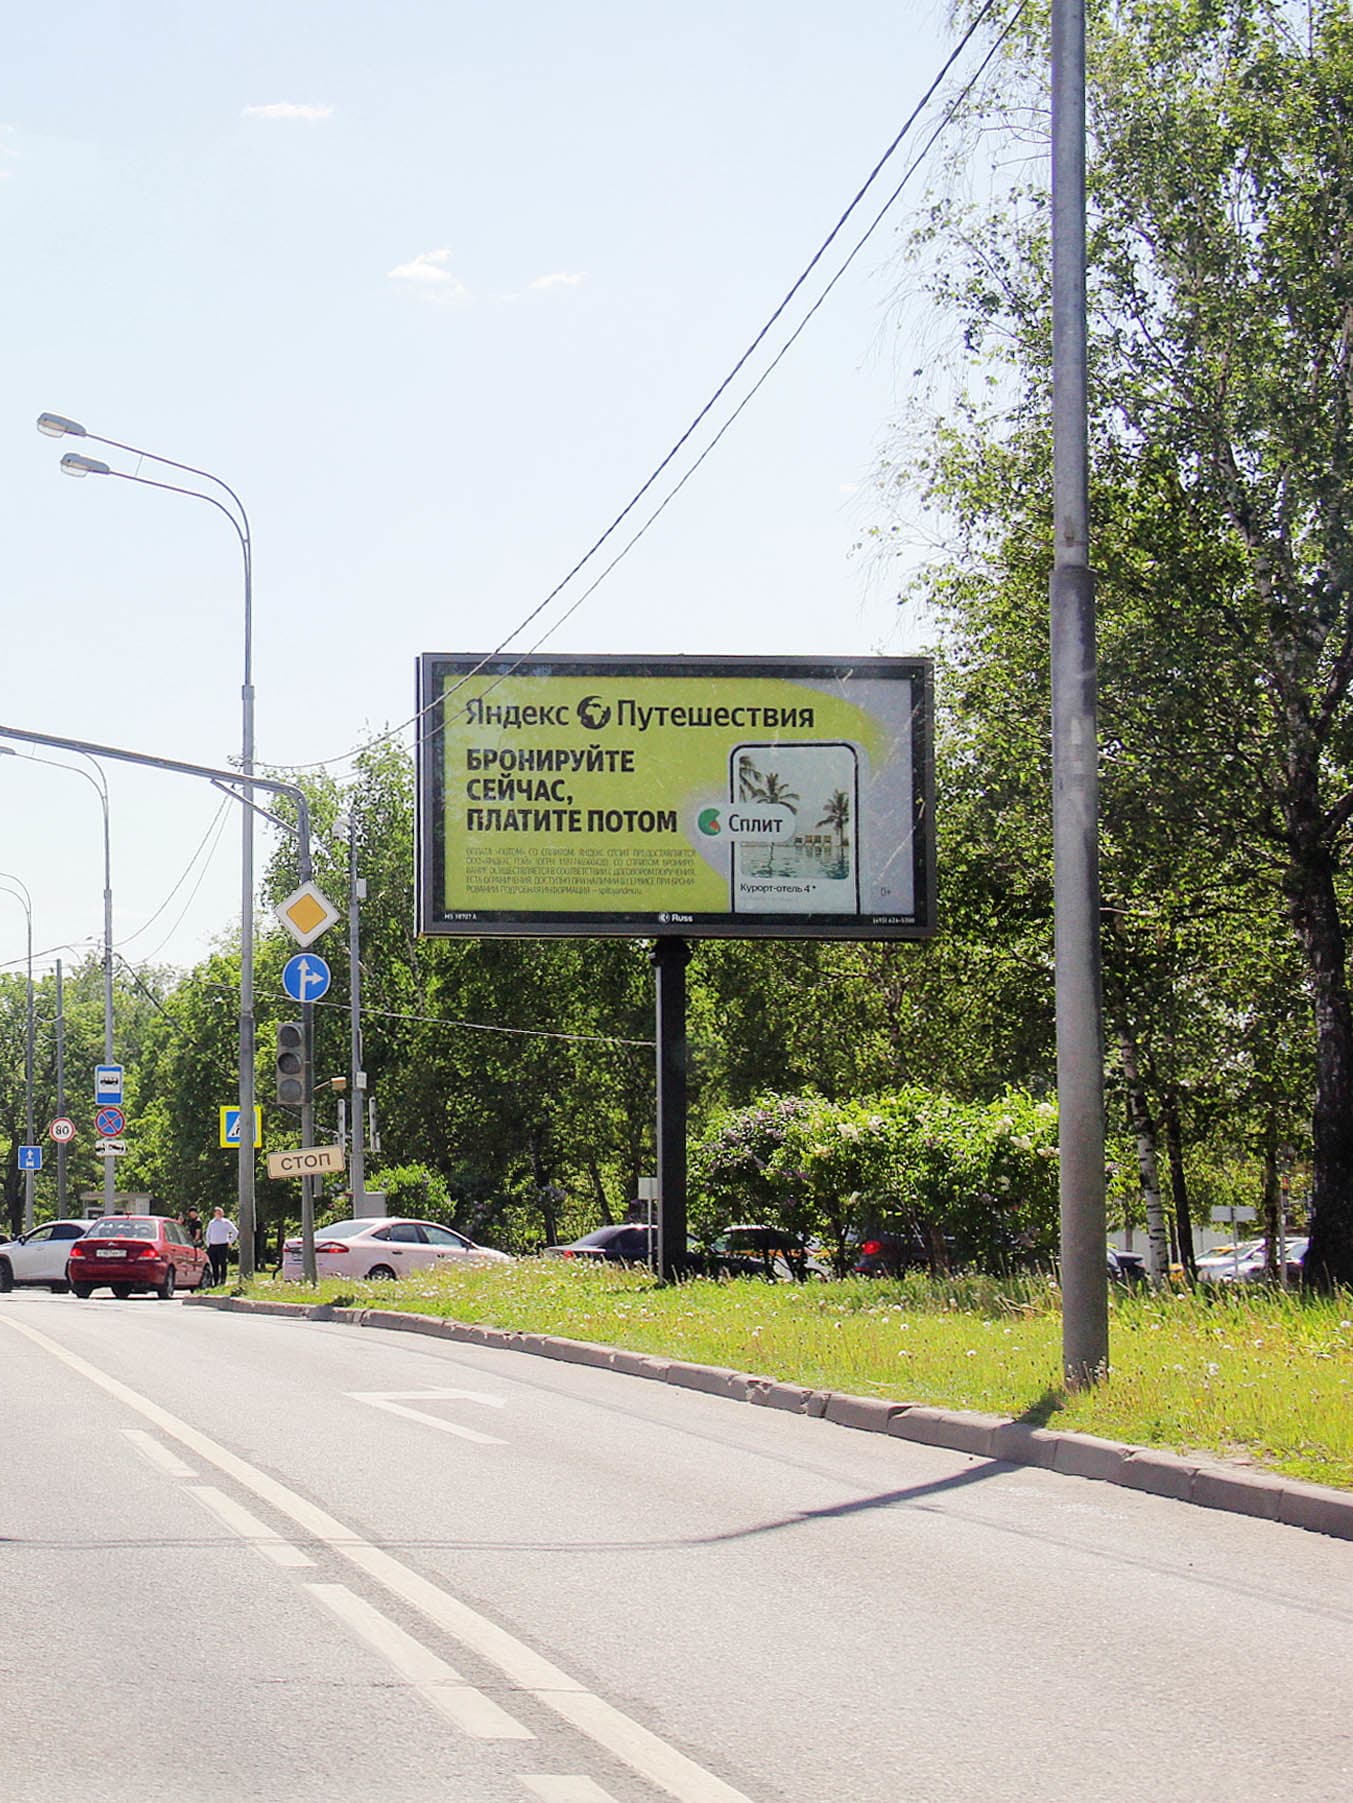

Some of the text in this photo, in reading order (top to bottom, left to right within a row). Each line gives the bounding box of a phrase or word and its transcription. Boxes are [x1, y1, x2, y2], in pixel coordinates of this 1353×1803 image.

[466, 698, 815, 731] Яндекс Путешествия
[466, 745, 635, 773] БРОНИРУЙТЕ
[466, 773, 574, 806] СЕЙЧАС,
[466, 809, 677, 833] ПЛАТИТЕ ПОТОМ
[728, 813, 784, 834] Сплит
[740, 883, 803, 893] Курорт-отель
[671, 913, 694, 922] Russ
[55, 1125, 69, 1135] 80
[281, 1153, 331, 1170] СТОП
